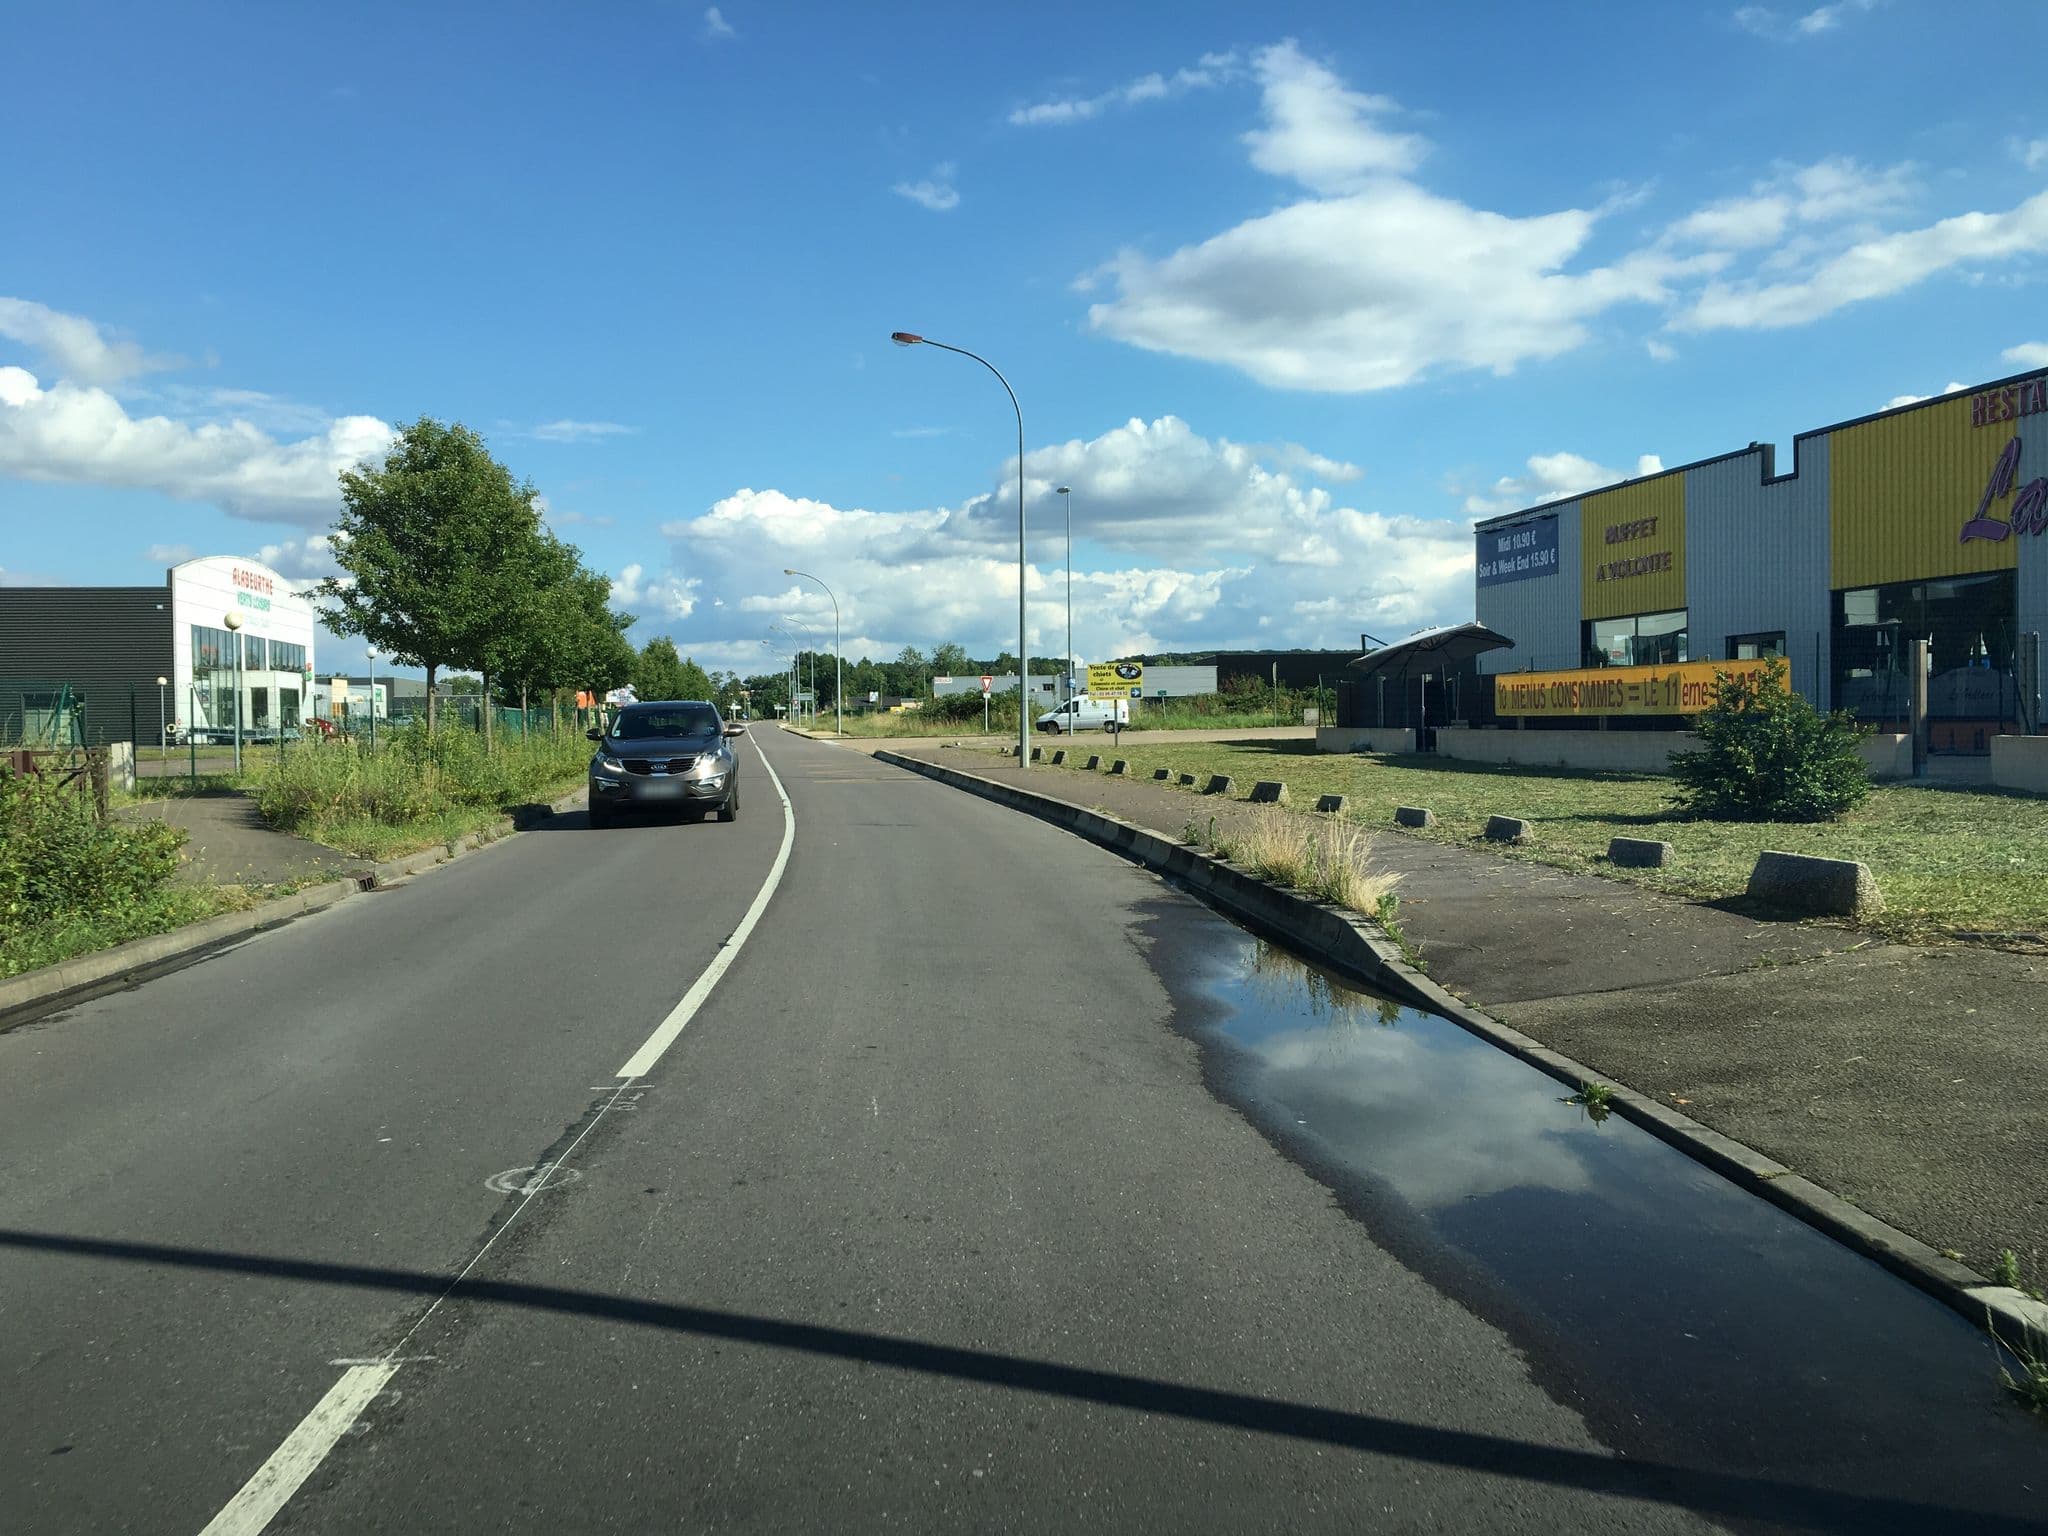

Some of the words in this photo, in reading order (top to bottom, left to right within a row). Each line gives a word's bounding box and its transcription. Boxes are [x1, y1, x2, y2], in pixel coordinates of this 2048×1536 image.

[1498, 535, 1511, 552] Midi
[1513, 532, 1530, 549] 10.90
[1531, 529, 1537, 545] €
[1605, 516, 1657, 544] BUFFET
[1479, 563, 1492, 578] Soir
[1492, 561, 1498, 576] &
[1498, 557, 1516, 575] Week
[1516, 554, 1530, 570] End
[1530, 551, 1548, 568] 15.90
[1511, 682, 1546, 709] MENUS
[1551, 679, 1624, 709] CONSOMMES
[1644, 677, 1658, 706] LE
